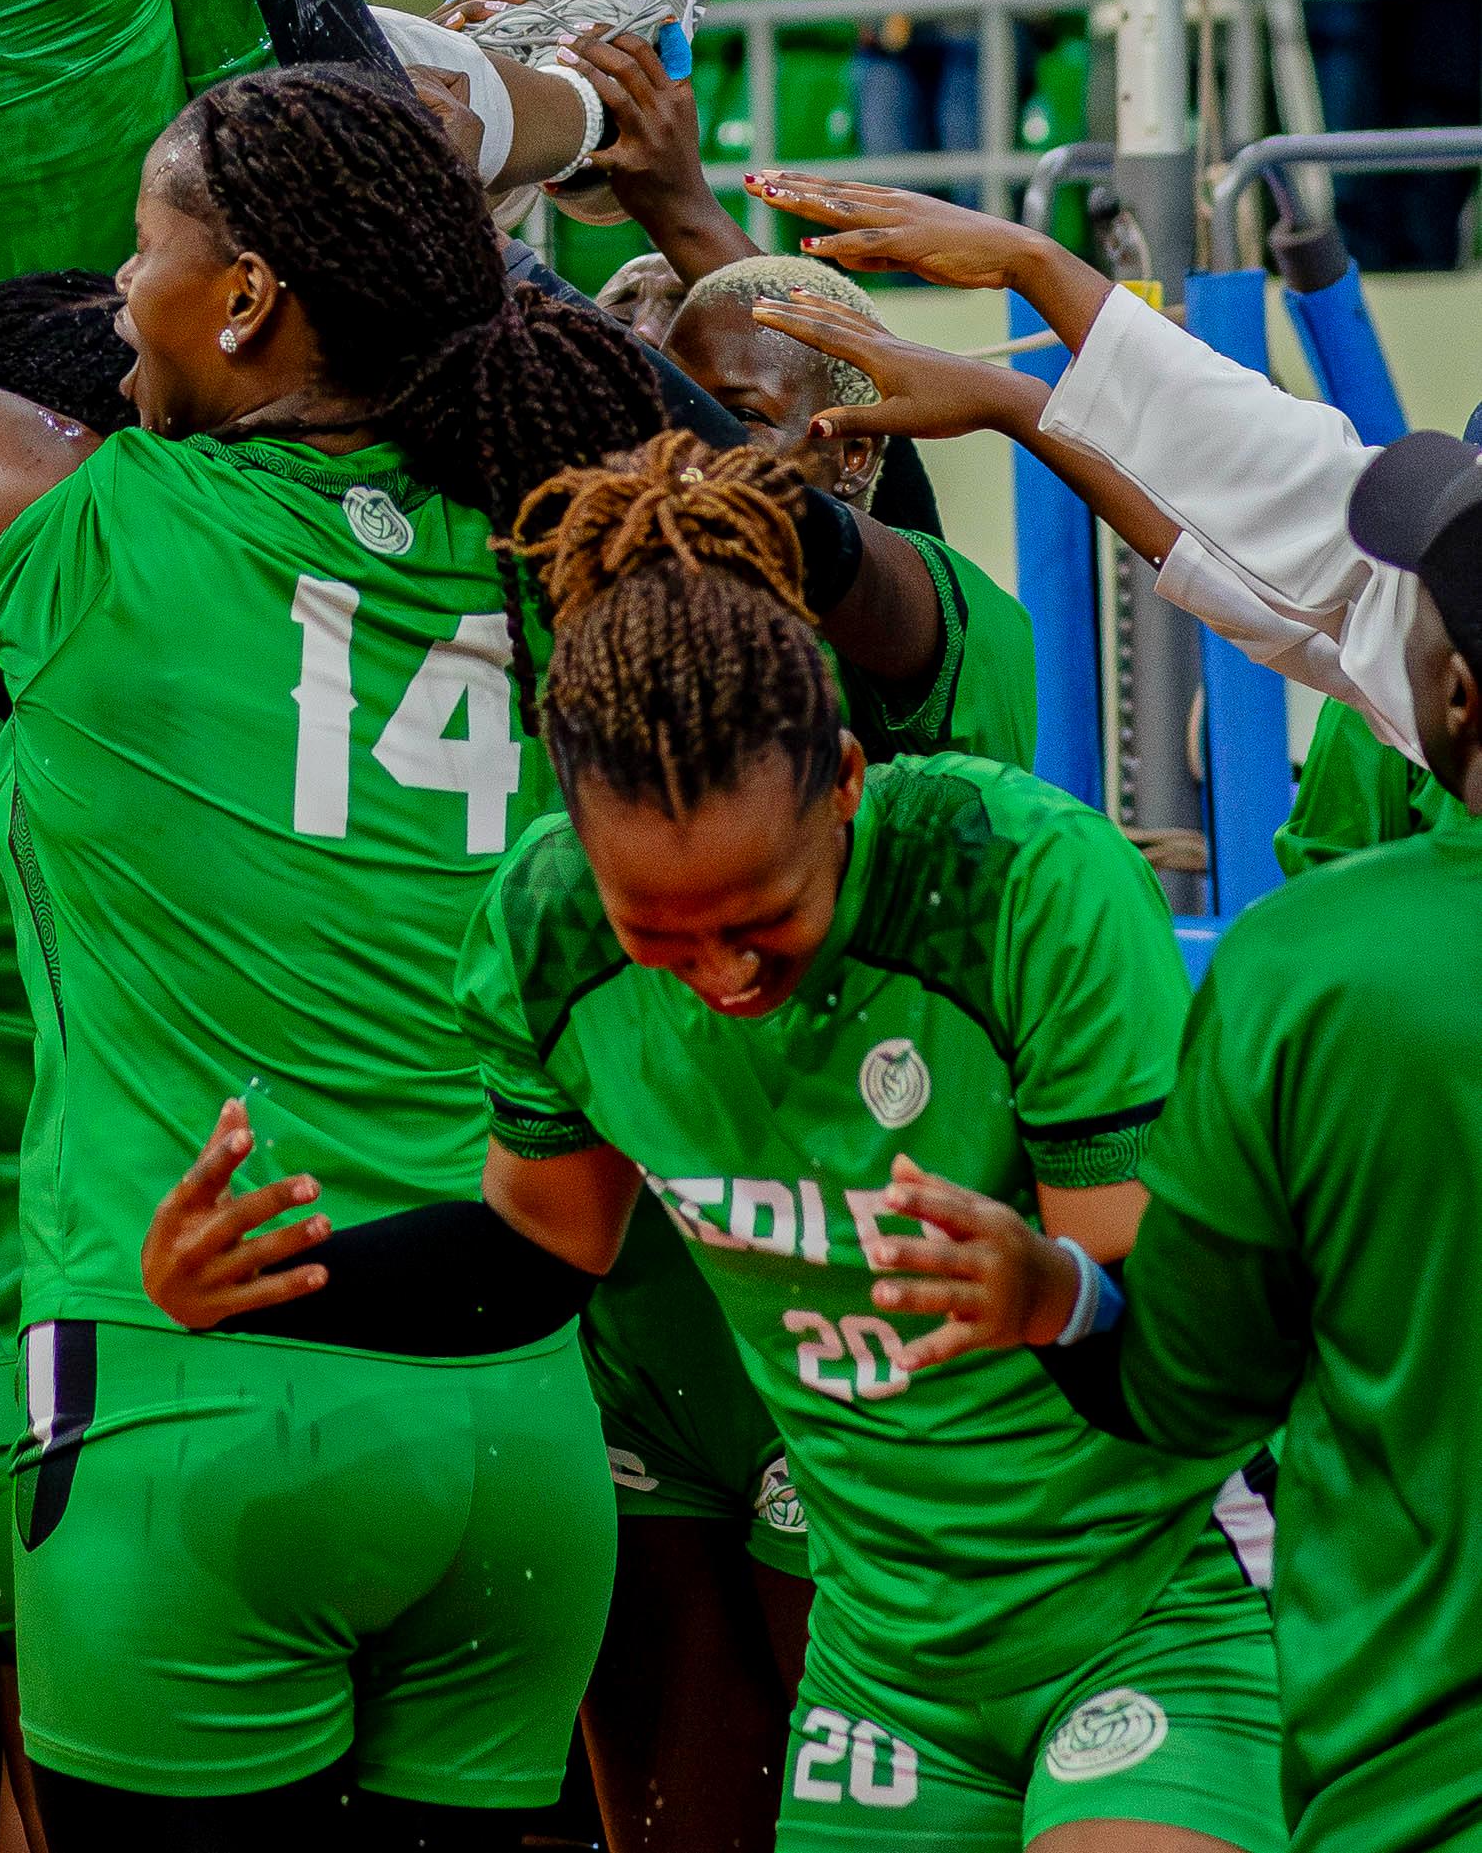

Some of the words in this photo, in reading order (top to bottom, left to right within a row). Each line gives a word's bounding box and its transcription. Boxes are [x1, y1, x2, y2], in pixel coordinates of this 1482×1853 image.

[290, 574, 521, 854] 14
[782, 1309, 909, 1402] 20
[793, 1706, 918, 1809] 20
